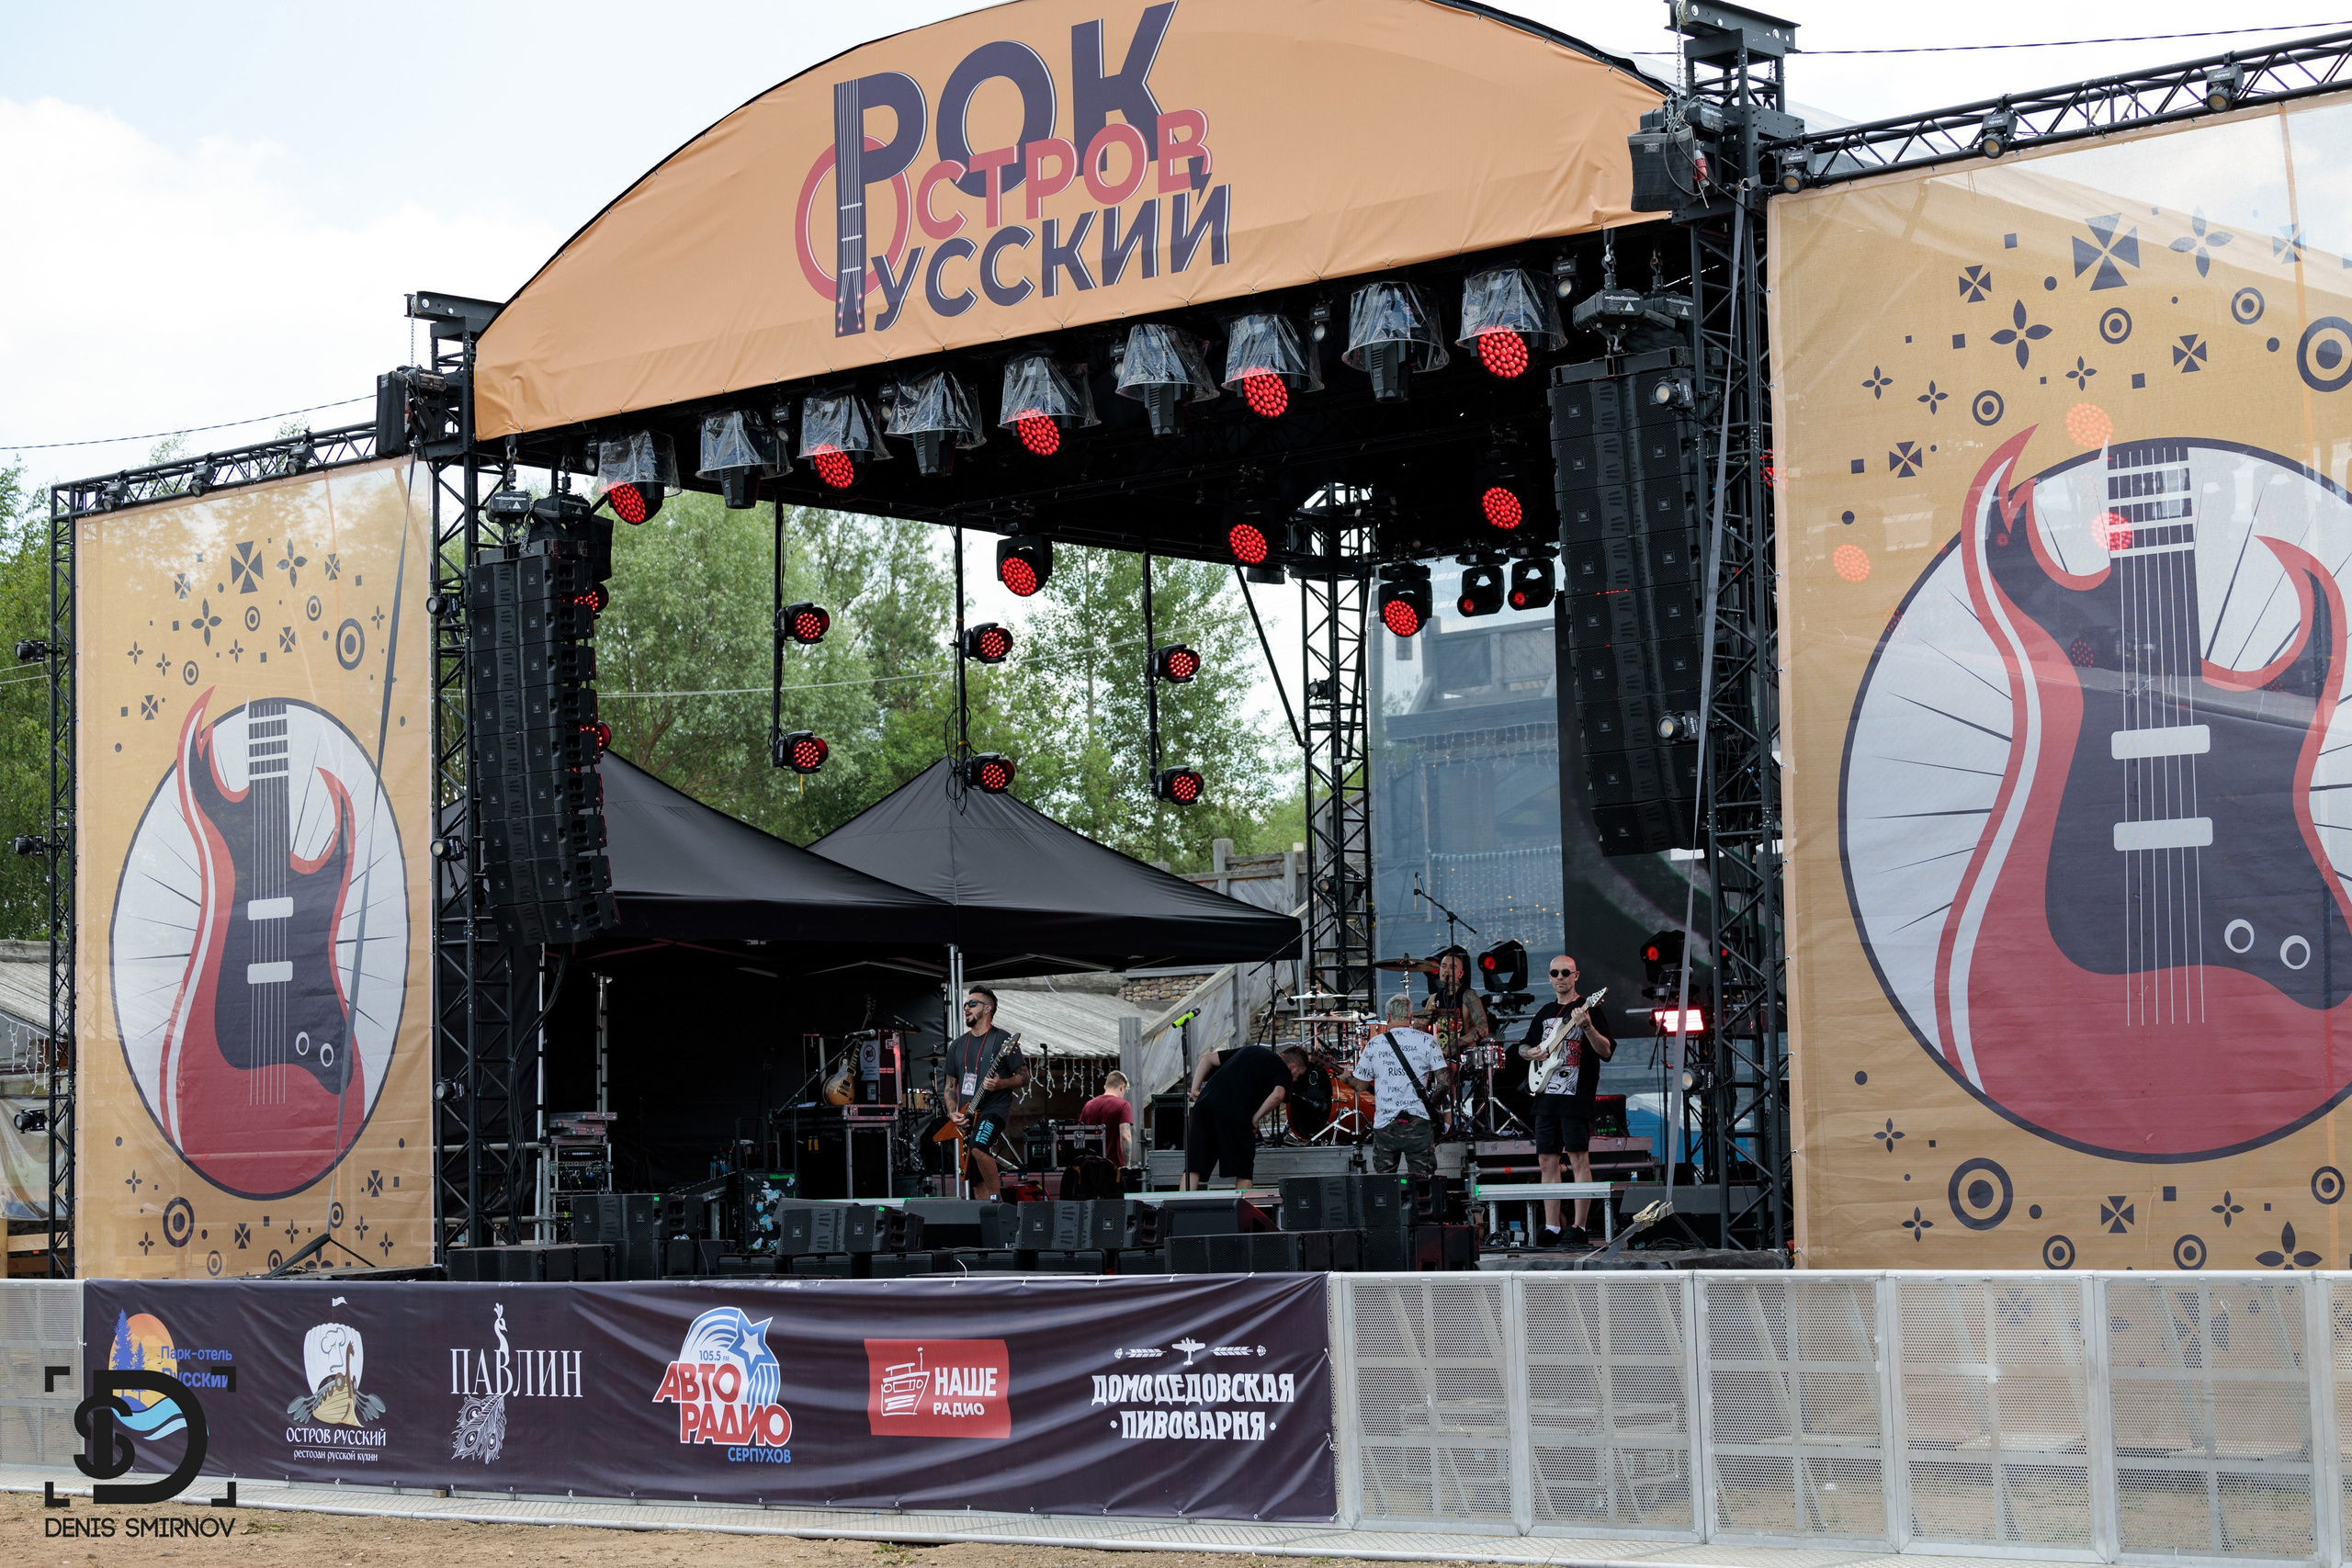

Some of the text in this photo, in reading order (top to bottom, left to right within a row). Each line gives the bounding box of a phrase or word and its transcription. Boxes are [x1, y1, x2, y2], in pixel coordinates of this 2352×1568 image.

[833, 0, 1180, 337] РОК
[795, 108, 1214, 302] ОСТРОВ
[1387, 1066, 1407, 1077] RUSS
[161, 1346, 232, 1362] Парк-отель
[699, 1350, 721, 1361] 105.5
[449, 1348, 583, 1397] ПАВЛИН
[652, 1361, 741, 1403] АВТО
[934, 1367, 998, 1396] НАШЕ
[1091, 1373, 1295, 1405] ДОМОДЕДОВСКАЯ
[933, 1402, 985, 1417] РАДИО
[286, 1427, 331, 1444] ОСТРОВ
[680, 1402, 792, 1447] РАДИО
[1120, 1410, 1265, 1440] ПИВОВАРНЯ
[294, 1450, 378, 1463] ресторан русской кухни
[728, 1447, 792, 1463] СЕРПУХОВ
